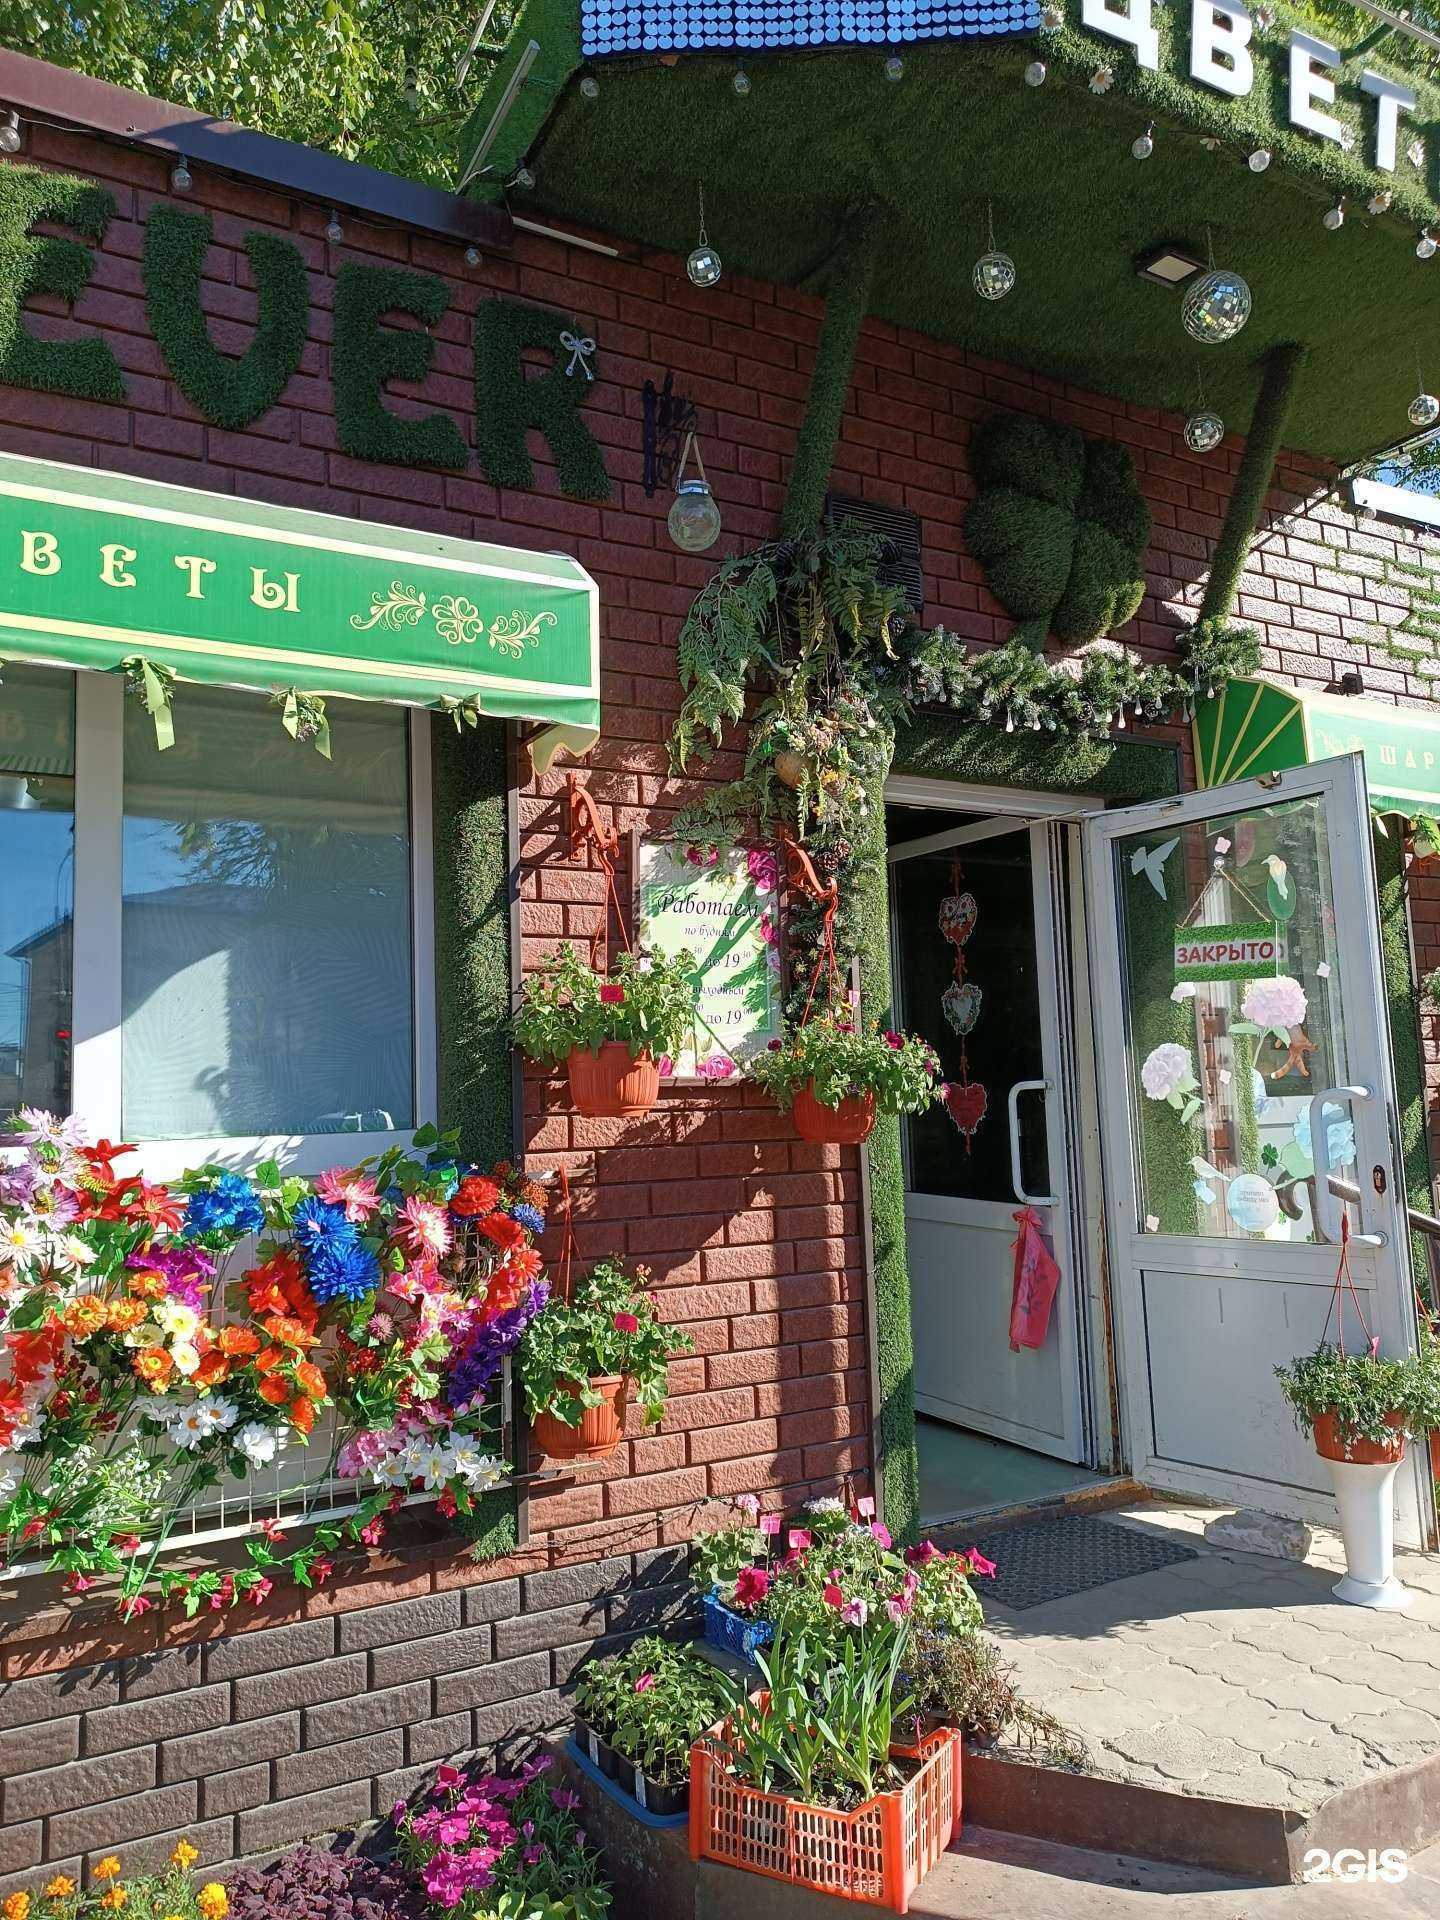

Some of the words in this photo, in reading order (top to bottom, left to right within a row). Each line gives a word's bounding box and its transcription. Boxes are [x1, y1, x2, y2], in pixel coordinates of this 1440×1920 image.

[20, 529, 301, 613] ВЕТЫ
[657, 891, 759, 918] Работаем
[1176, 941, 1275, 964] ЗАКРЫТО
[725, 1010, 742, 1025] 19
